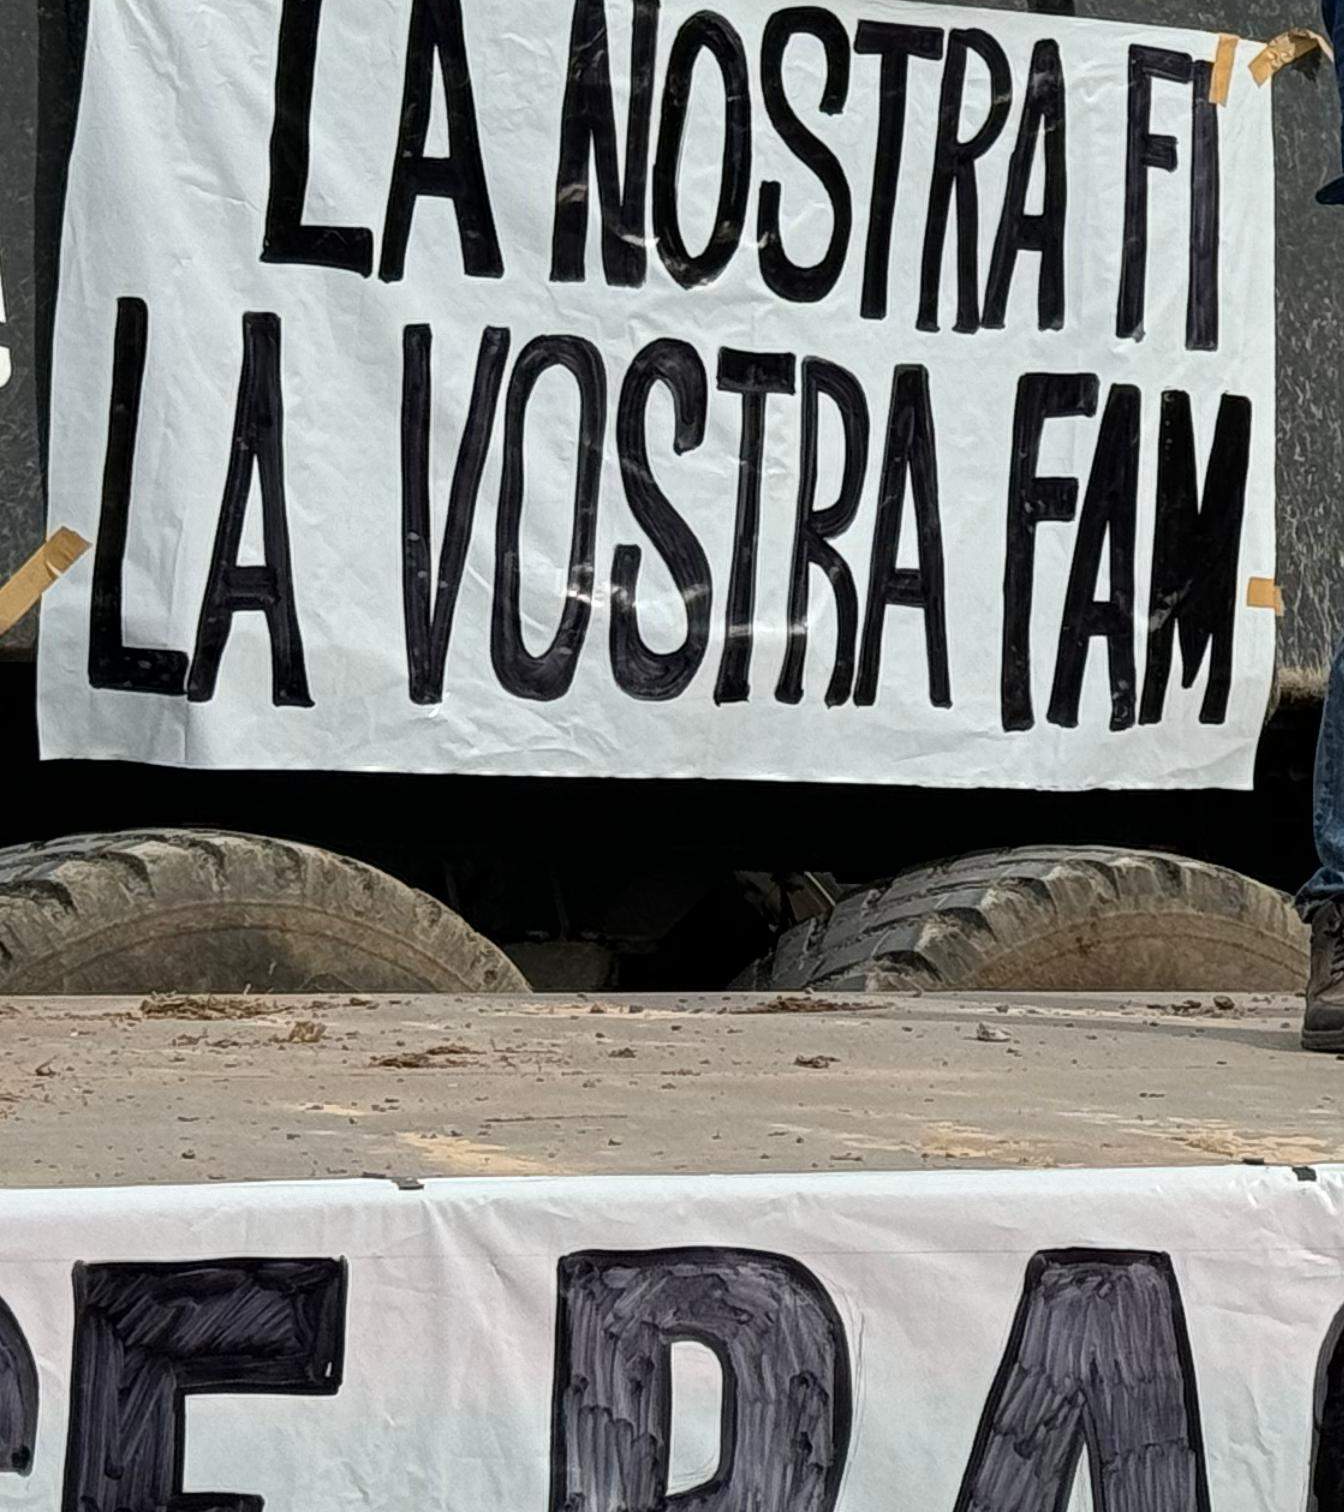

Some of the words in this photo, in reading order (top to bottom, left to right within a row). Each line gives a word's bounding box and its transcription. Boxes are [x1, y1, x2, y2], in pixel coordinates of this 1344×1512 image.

[1116, 43, 1222, 352] FI
[88, 296, 315, 709] LA
[401, 322, 955, 708] VOSTRA
[1000, 371, 1254, 733] FAM
